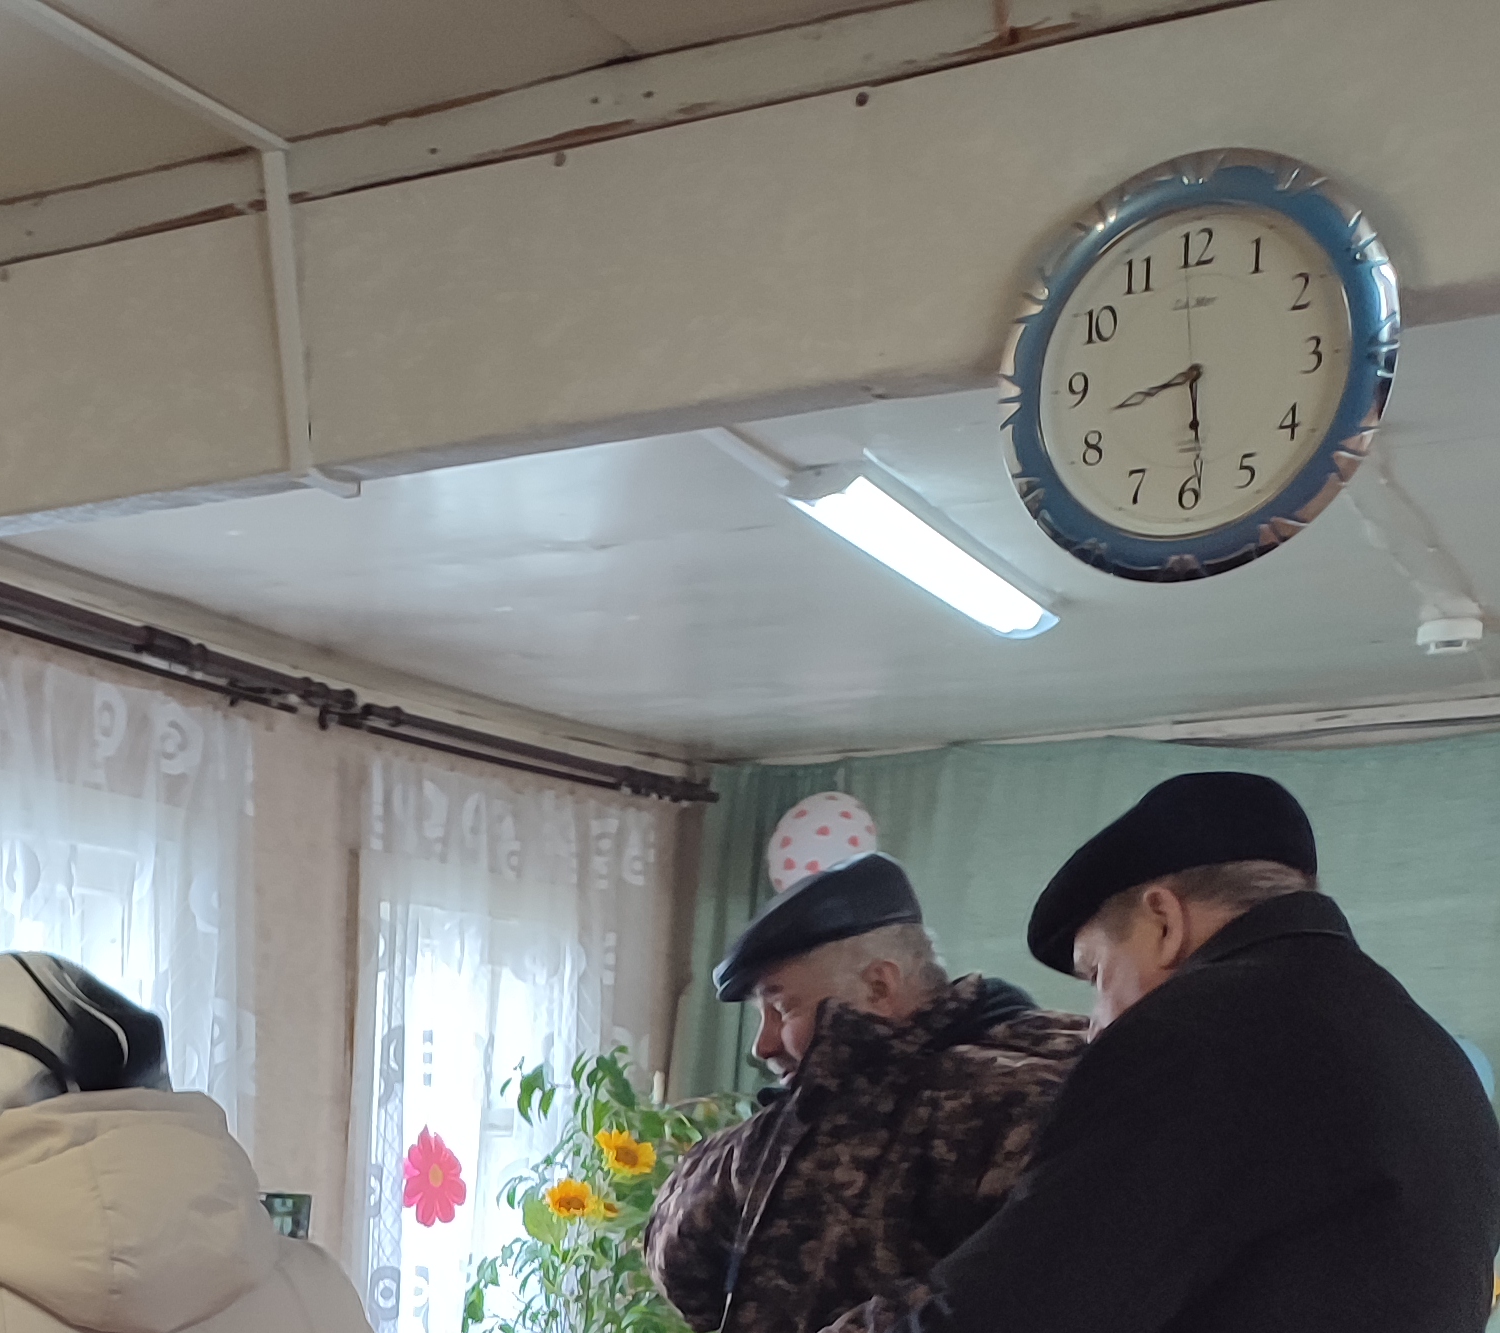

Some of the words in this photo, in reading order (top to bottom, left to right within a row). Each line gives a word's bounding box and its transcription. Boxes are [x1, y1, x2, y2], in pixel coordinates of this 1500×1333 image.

[1178, 228, 1215, 270] 12
[1250, 237, 1265, 274] 1
[1124, 256, 1153, 295] 11
[1288, 273, 1311, 311] 2
[1083, 305, 1117, 345] 10
[1300, 336, 1322, 373] 3
[1068, 372, 1089, 409] 9
[1277, 402, 1301, 441] 4
[1082, 430, 1103, 466] 8
[1128, 468, 1147, 505] 7
[1235, 453, 1257, 489] 5
[1178, 474, 1200, 510] 6
